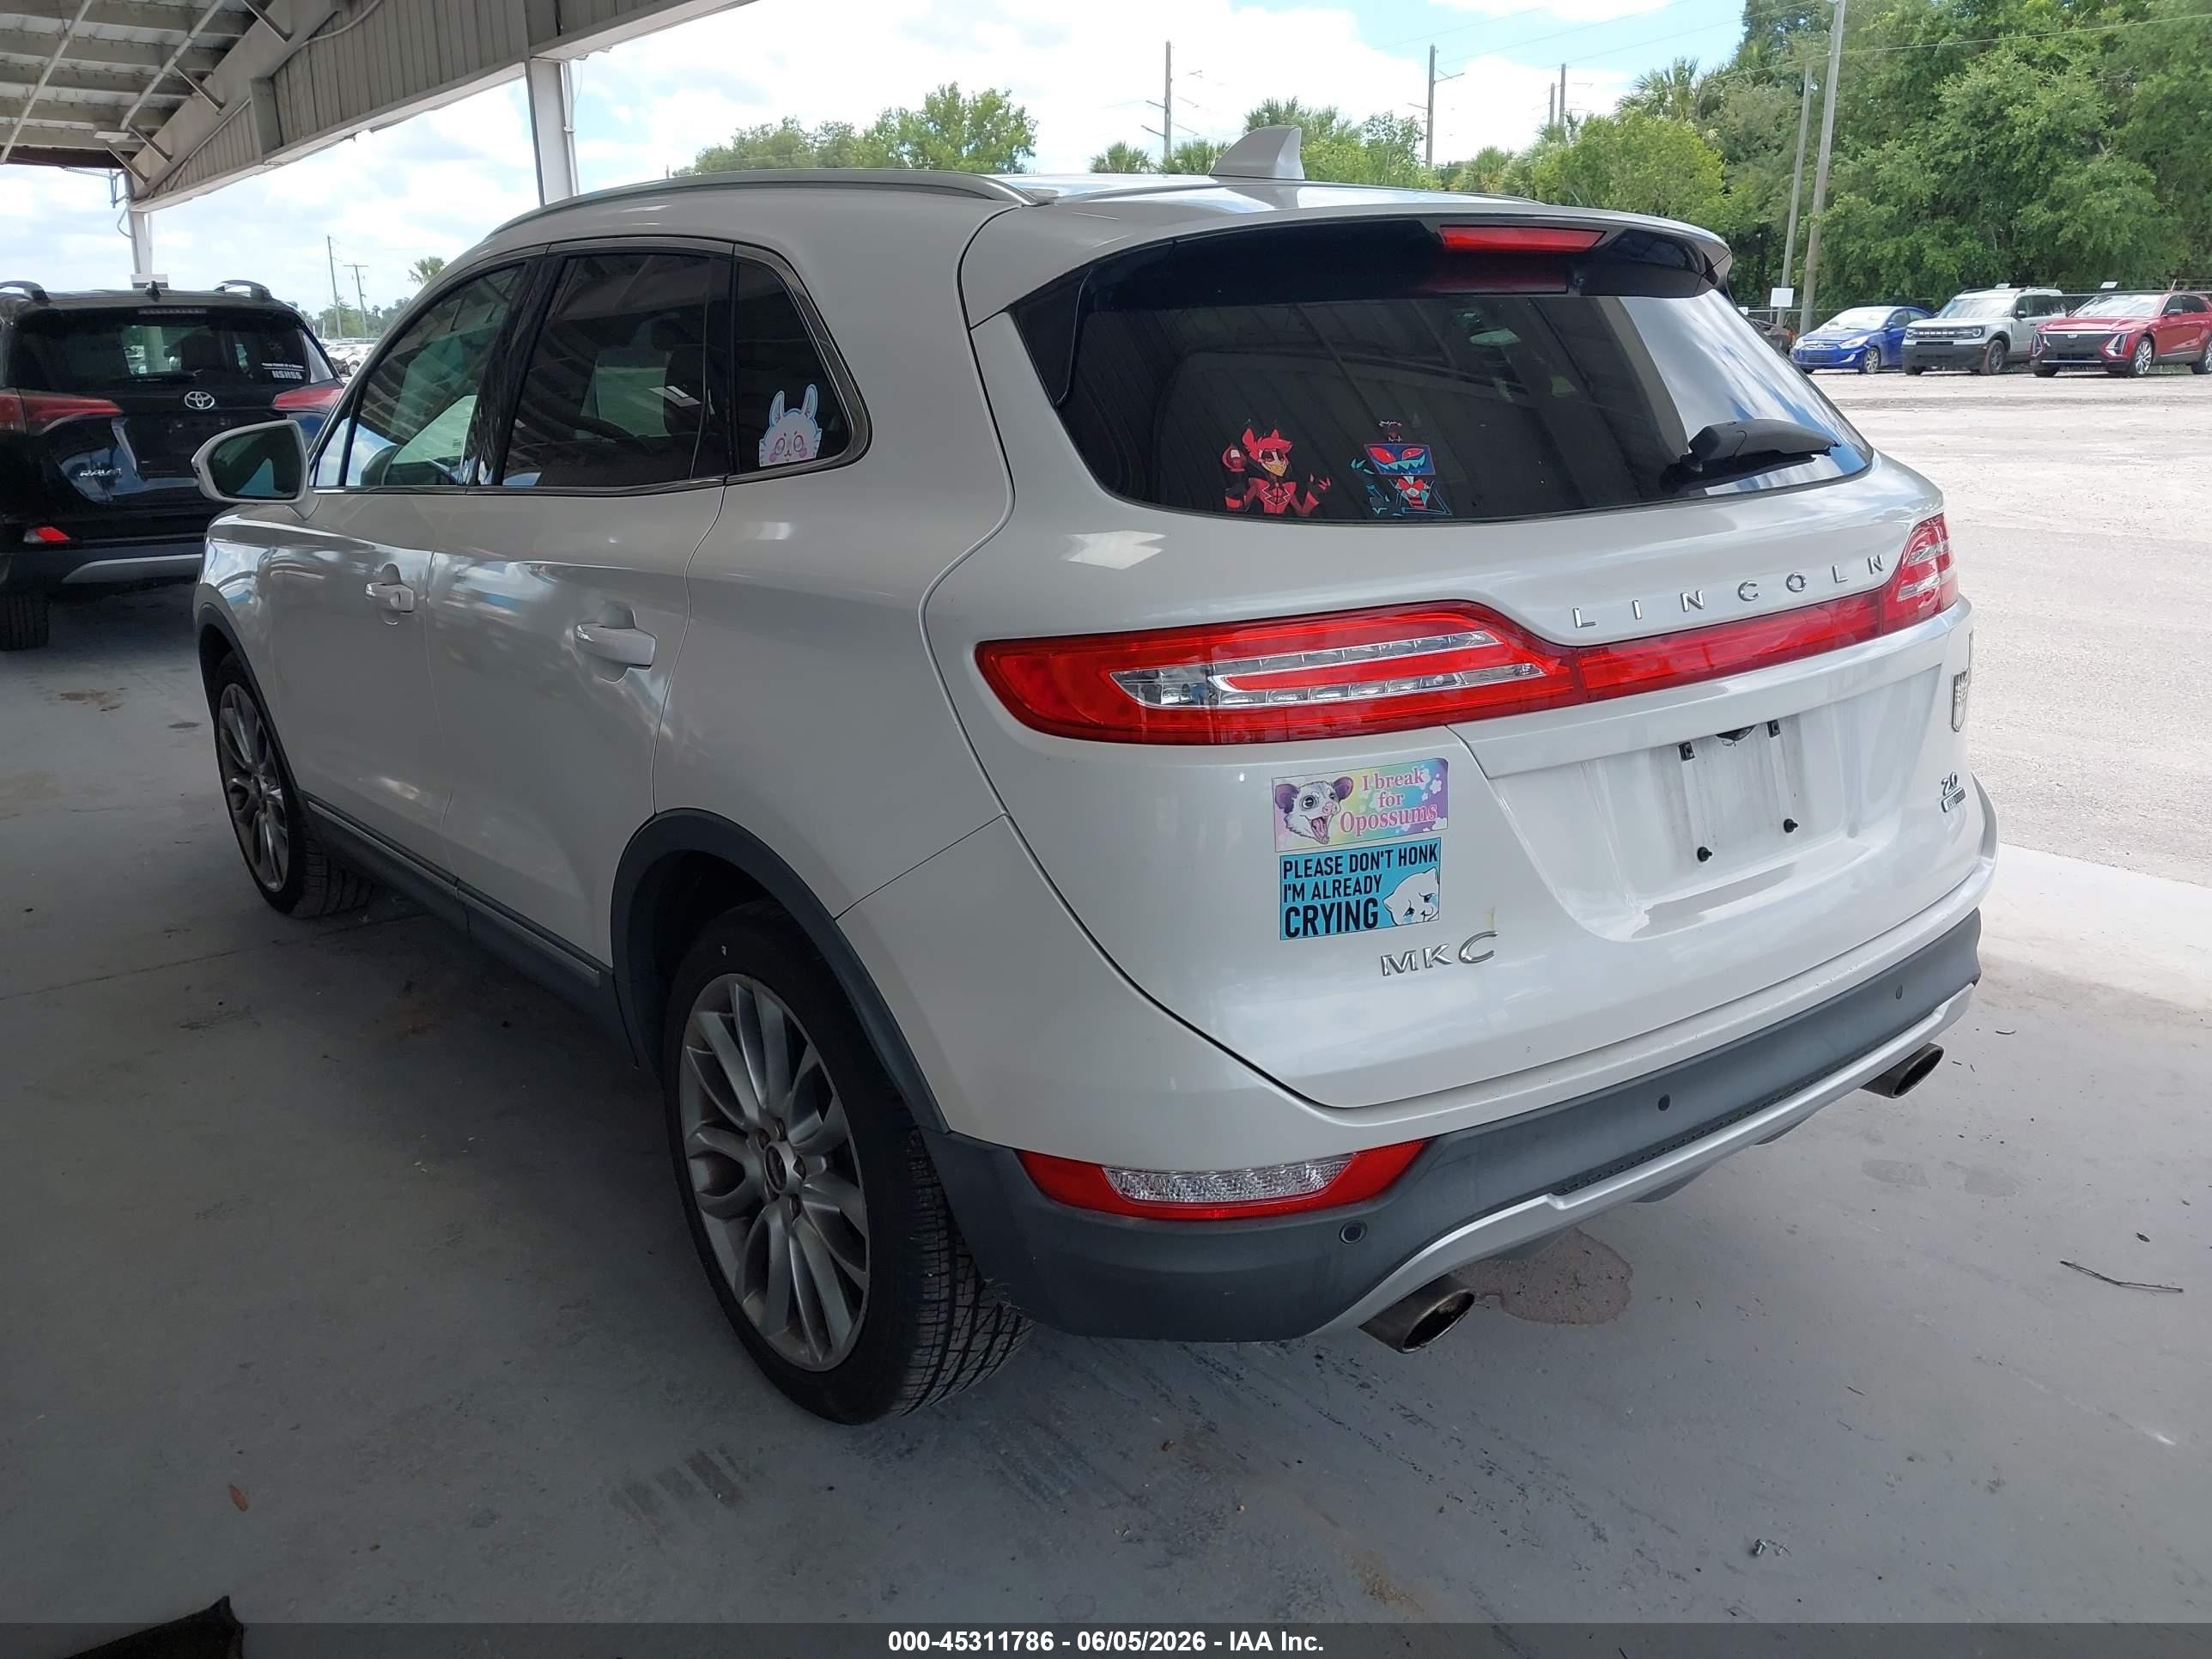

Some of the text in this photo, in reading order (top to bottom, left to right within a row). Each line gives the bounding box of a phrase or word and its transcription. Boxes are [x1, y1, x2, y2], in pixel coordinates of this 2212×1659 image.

[1572, 554, 1885, 628] LINCOLN
[1361, 768, 1425, 791] I break
[1377, 792, 1405, 808] for
[1340, 805, 1437, 836] Opossums
[1283, 843, 1438, 879] PLEASE DON'T HONK
[1283, 873, 1382, 903] I'M ALREADY
[1285, 898, 1378, 938] CRYING
[1381, 931, 1498, 976] MKC
